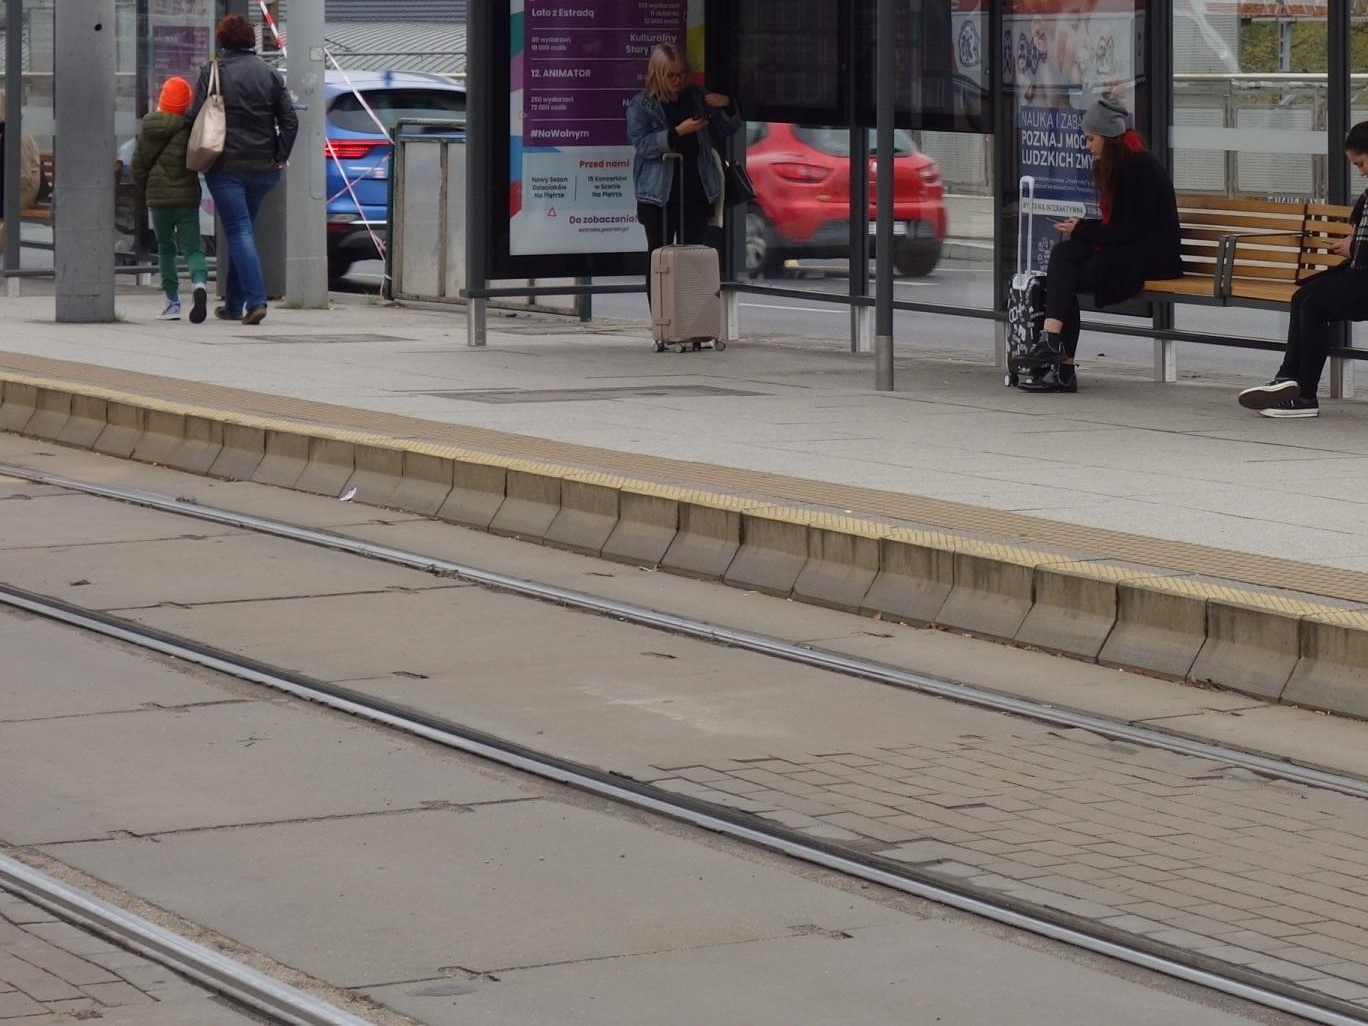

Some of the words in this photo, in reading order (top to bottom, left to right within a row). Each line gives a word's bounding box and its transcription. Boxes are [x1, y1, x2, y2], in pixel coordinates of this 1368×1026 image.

[551, 9, 557, 17] z
[558, 7, 595, 19] Estradą
[630, 33, 678, 45] Kulturalny
[530, 70, 542, 78] 12.
[542, 69, 592, 78] ANIMATOR
[1021, 111, 1054, 128] NAUKA
[1060, 113, 1083, 130] ZABA
[530, 129, 590, 140] #NaWolnym
[1021, 130, 1063, 148] POZNAJ
[579, 158, 604, 168] Przed
[605, 159, 630, 168] nami
[1022, 149, 1074, 168] LUDZKICH
[1075, 153, 1095, 171] ZMY
[569, 215, 582, 224] Do
